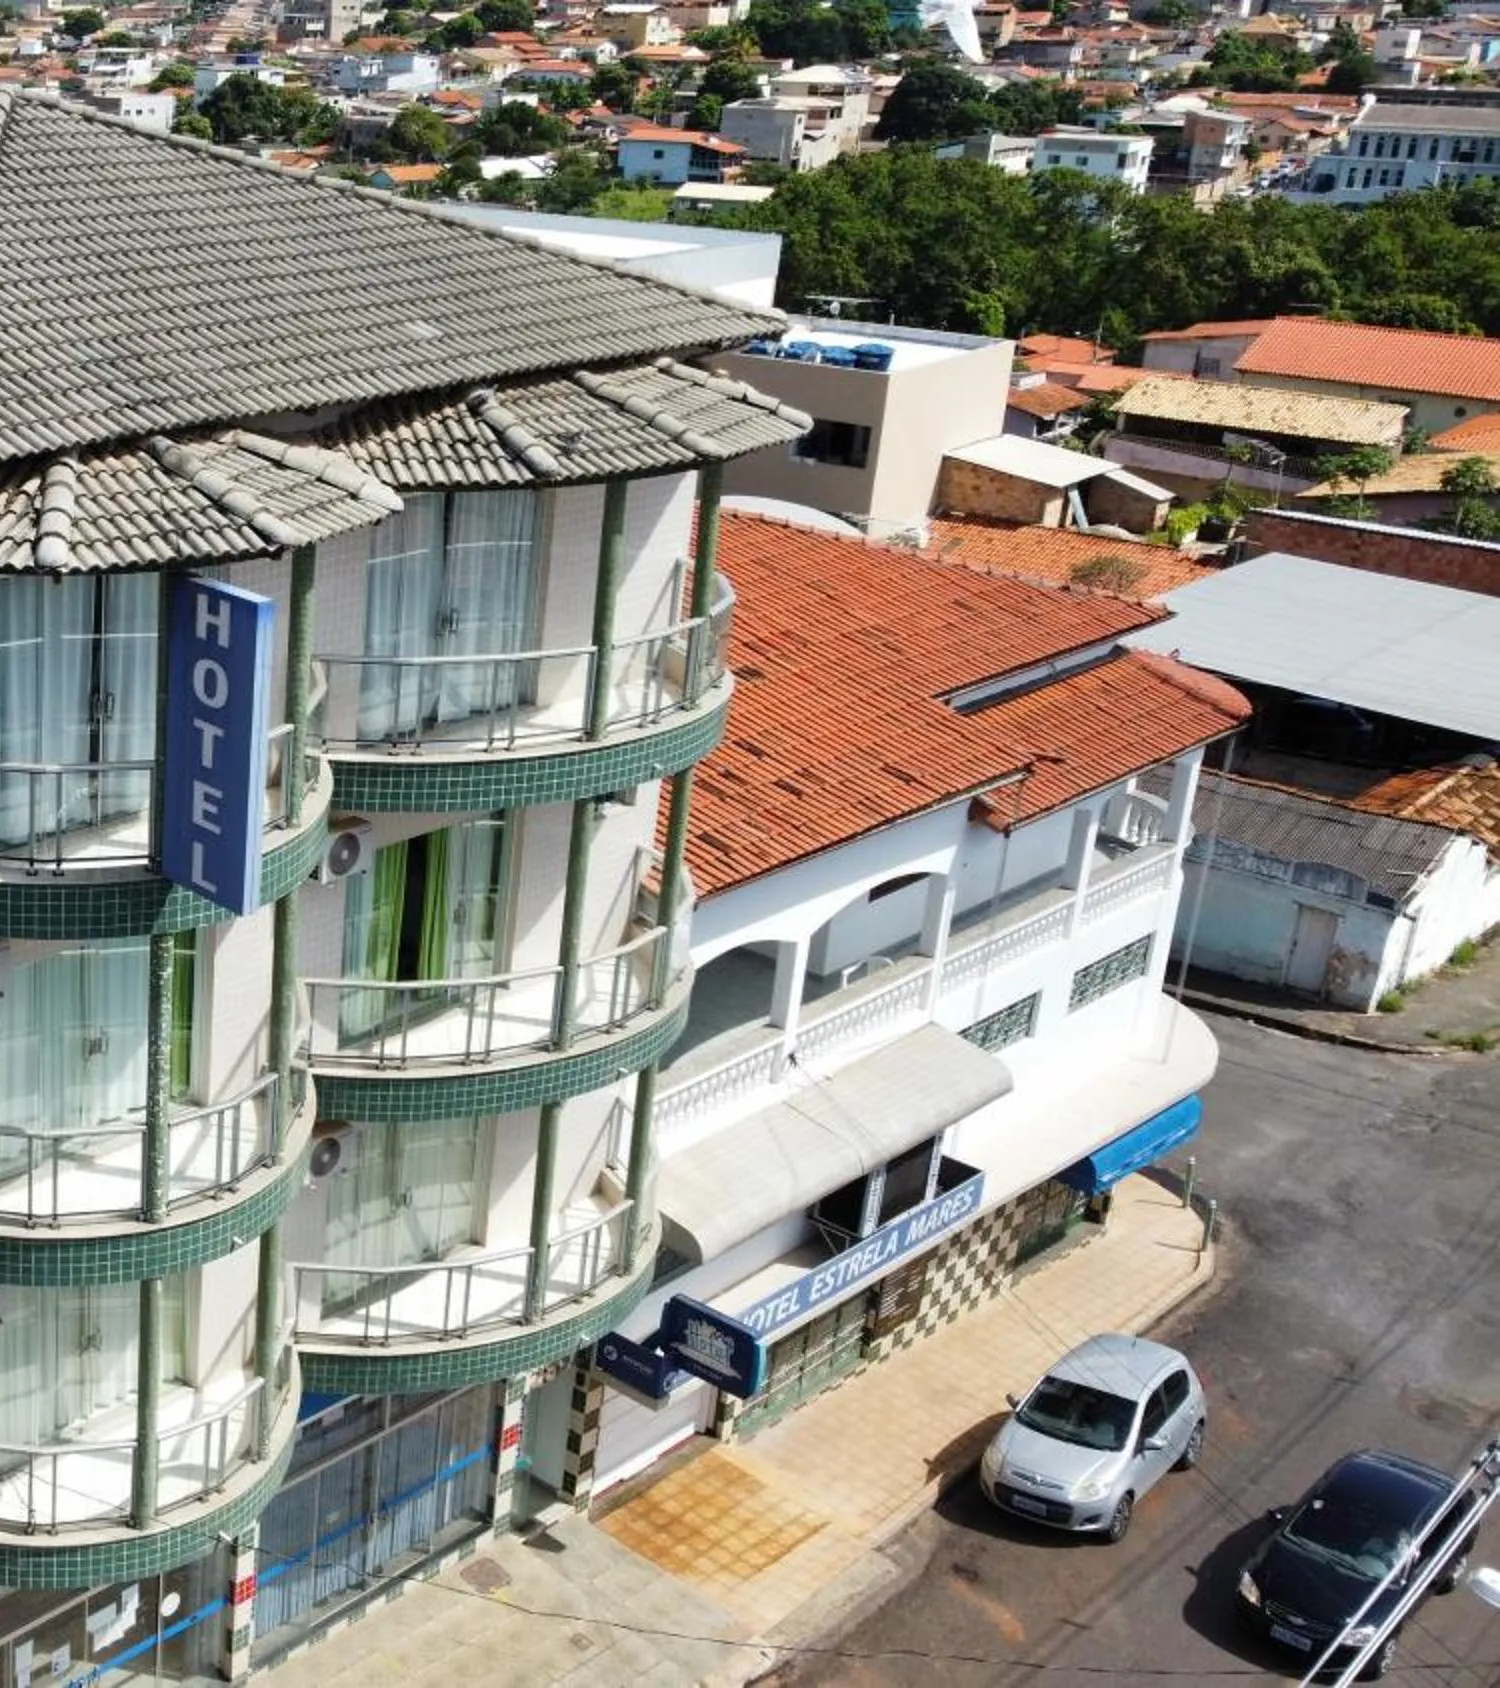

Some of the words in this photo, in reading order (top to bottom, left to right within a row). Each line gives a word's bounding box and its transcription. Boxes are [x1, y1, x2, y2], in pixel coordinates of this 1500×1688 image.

[191, 593, 231, 894] HOTEL
[744, 1287, 801, 1331] OTEL
[810, 1230, 898, 1302] ESTRELA
[905, 1185, 975, 1246] MARES
